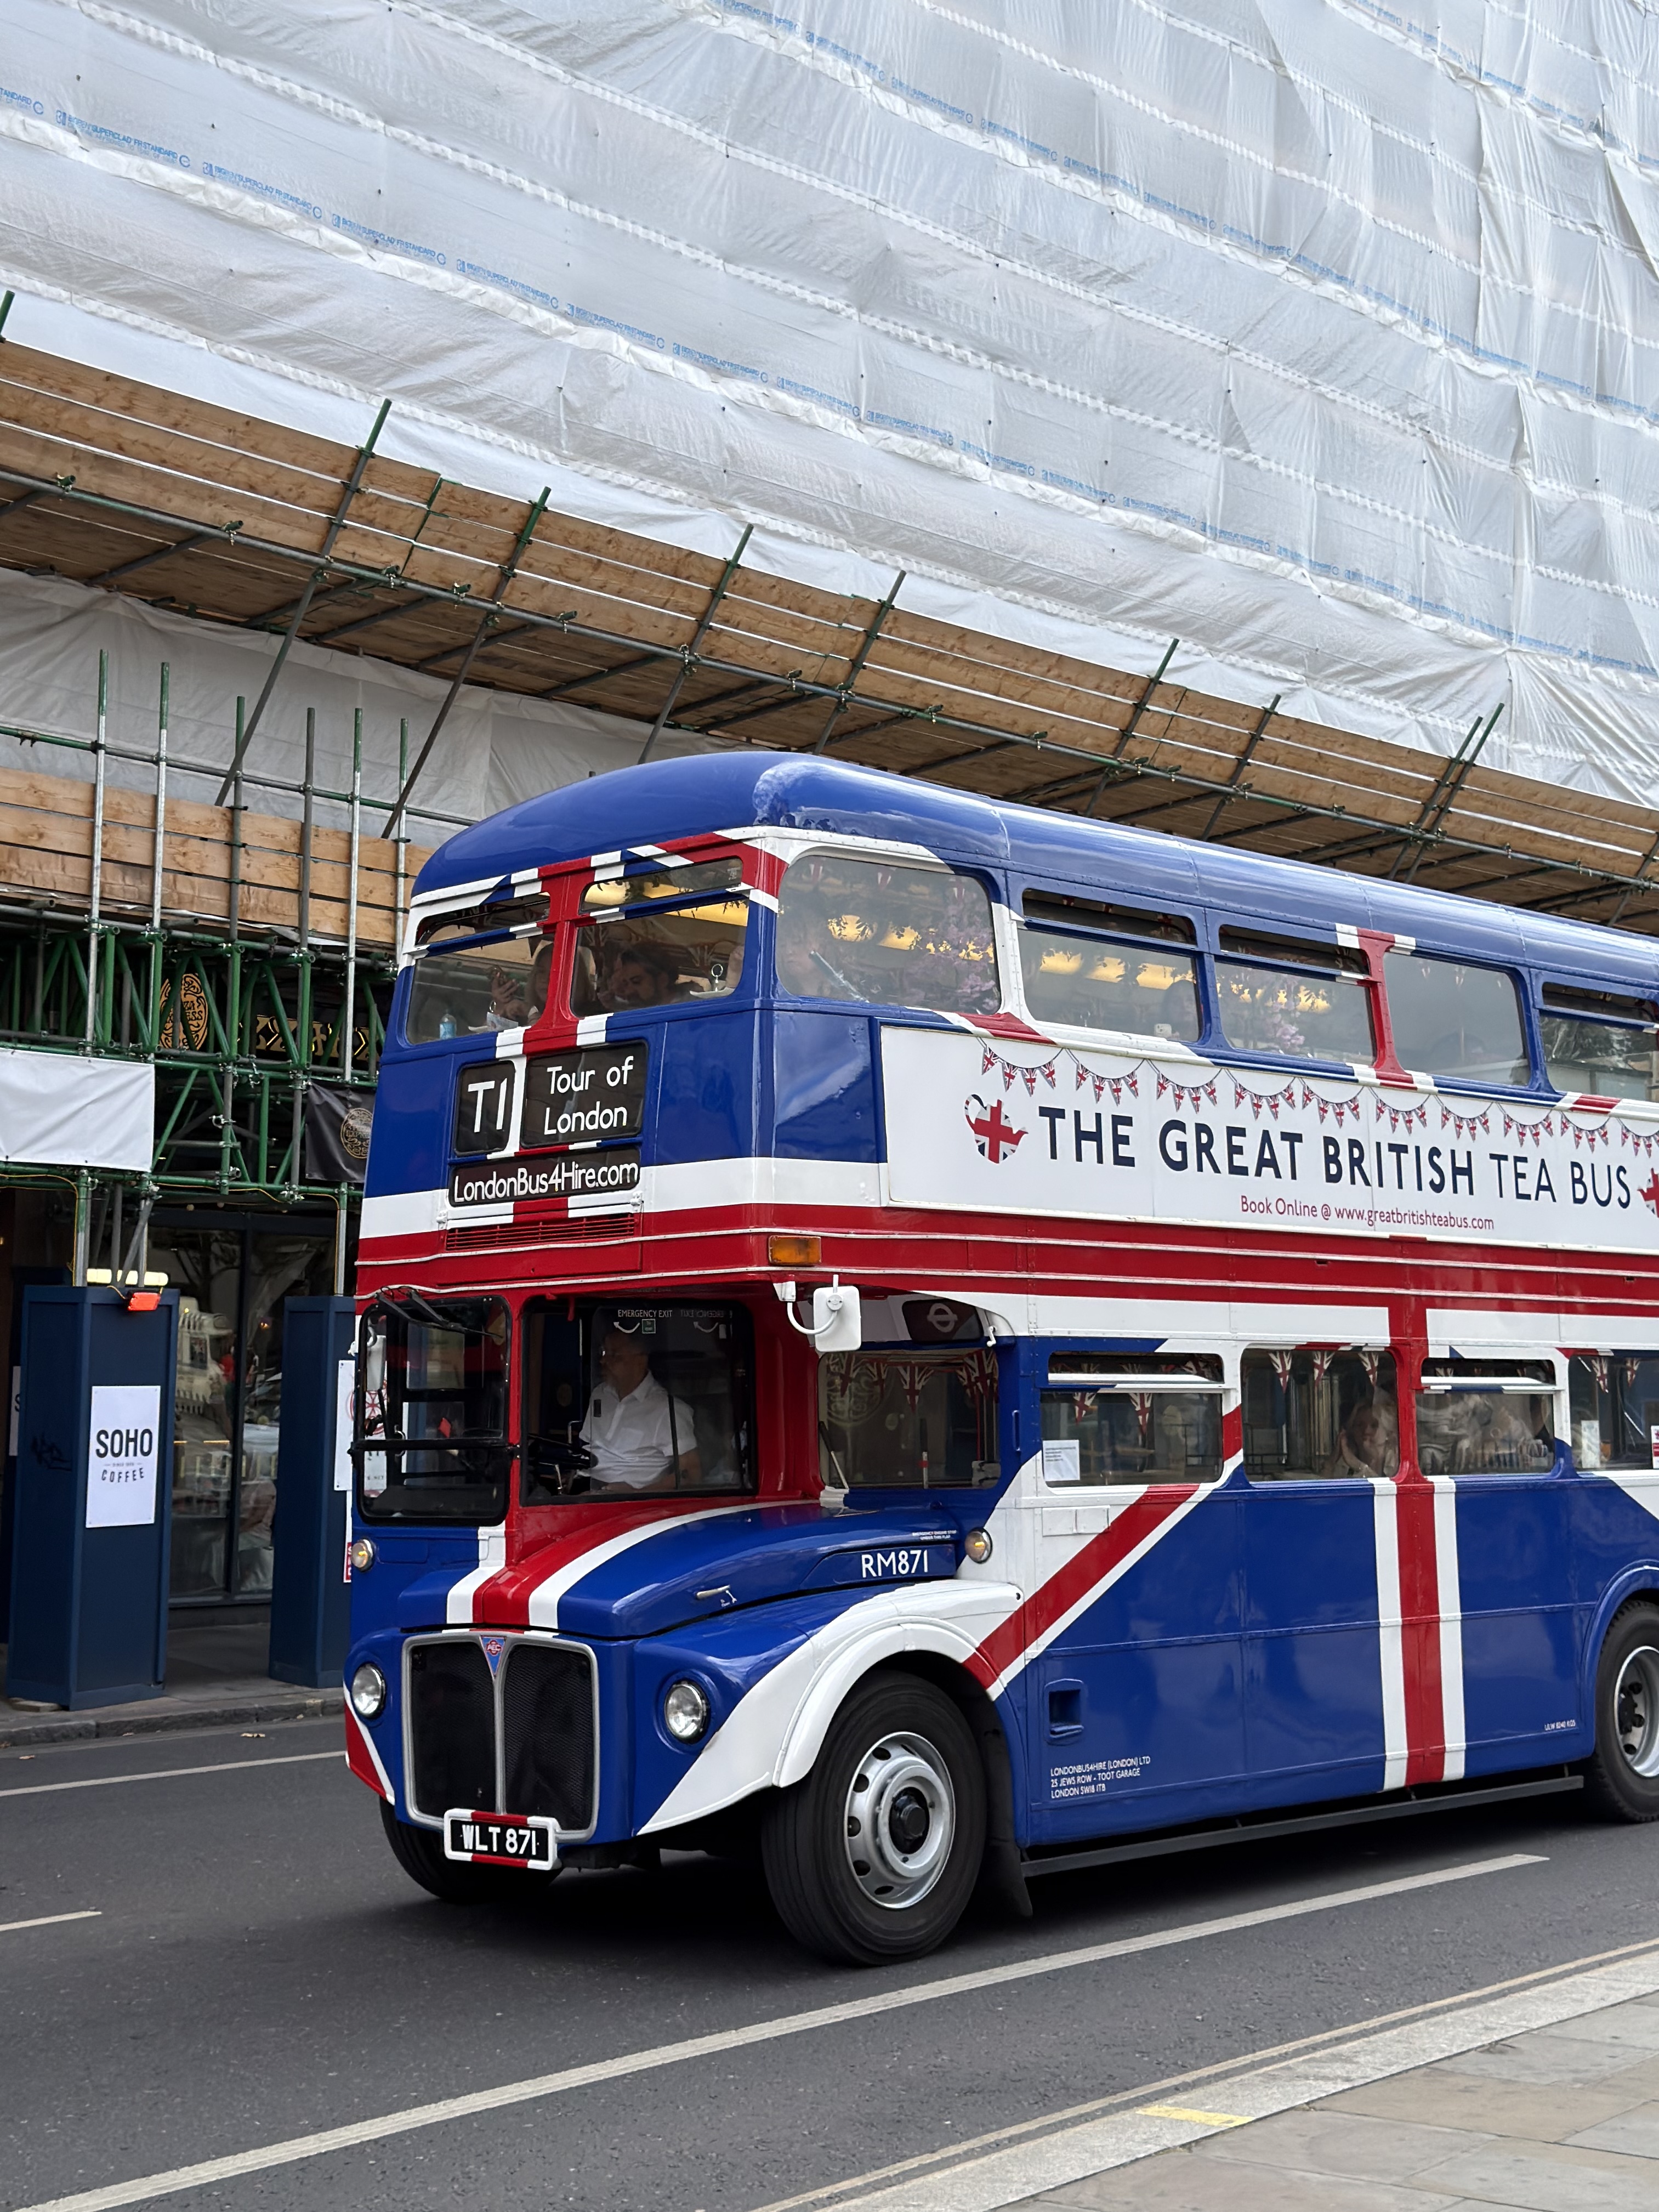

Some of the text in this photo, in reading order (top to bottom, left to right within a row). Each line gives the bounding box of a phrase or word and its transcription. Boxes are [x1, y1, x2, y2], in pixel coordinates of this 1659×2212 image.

[547, 1055, 634, 1094] Tour of
[467, 1077, 508, 1134] T1
[544, 1101, 627, 1136] London
[1038, 1105, 1631, 1210] THE GREAT BRITISH TEA BUS
[453, 1160, 639, 1203] LondonBus4Hire.com
[1241, 1195, 1495, 1230] Book Online @ www.greatbritishteabus.com
[618, 1309, 673, 1318] EMERGENCY EXIT
[95, 1428, 154, 1459] SOHO
[101, 1467, 145, 1483] COFFEE
[861, 1549, 929, 1578] RM871
[1050, 1755, 1151, 1777] LONDONBUS4HIRE (LONDON) LTD
[1050, 1779, 1058, 1788] 25
[1059, 1777, 1076, 1787] JEWS
[1077, 1774, 1092, 1785] ROW
[1098, 1771, 1115, 1781] TOOT
[1116, 1767, 1140, 1779] GARAGE
[1051, 1787, 1080, 1799] LONDON
[1080, 1785, 1095, 1795] SW18
[462, 1824, 537, 1856] WLT 871
